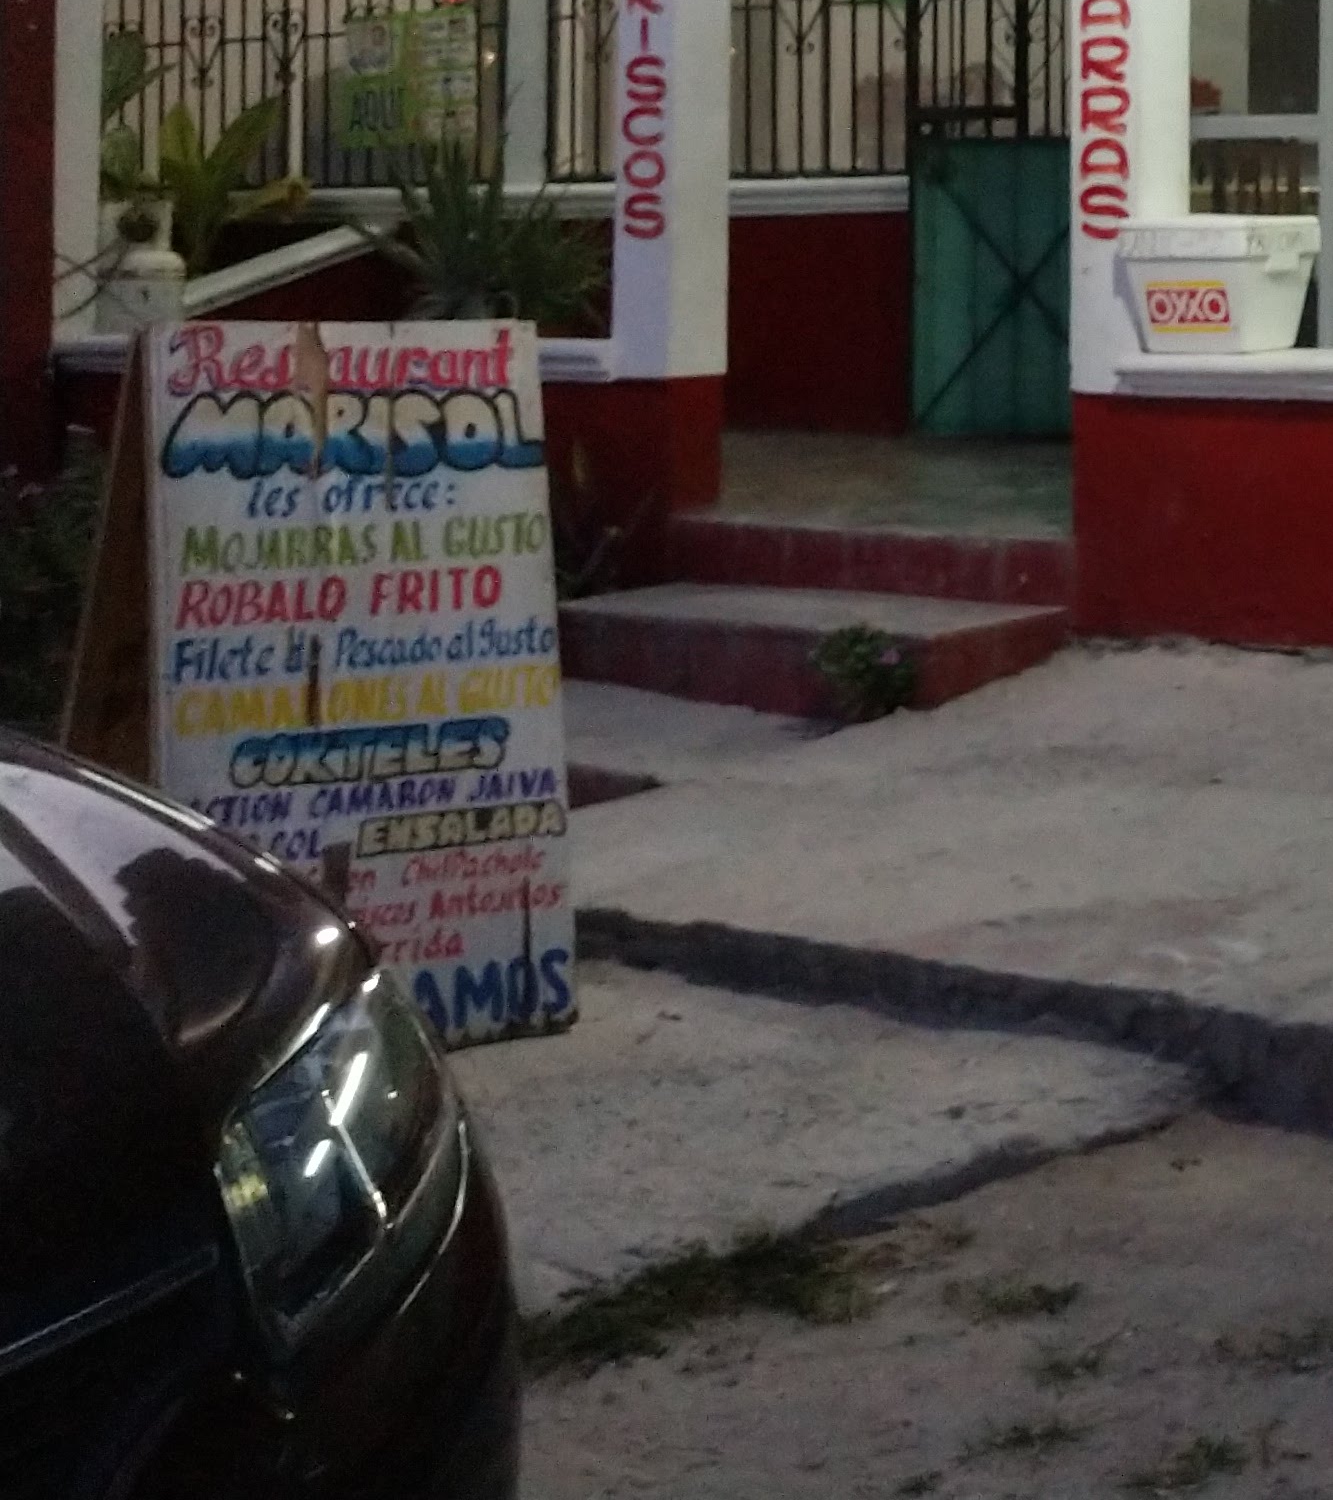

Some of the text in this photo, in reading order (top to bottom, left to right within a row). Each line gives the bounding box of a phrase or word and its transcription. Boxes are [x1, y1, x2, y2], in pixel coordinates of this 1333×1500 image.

[1148, 288, 1229, 323] OXXO
[168, 325, 514, 396] Resaurant
[162, 388, 545, 480] MARISOL
[246, 479, 298, 518] les
[181, 511, 548, 576] MOJARRAS AL GUSTO
[176, 565, 504, 631] ROBALO FRITO
[173, 633, 276, 684] Filete
[335, 627, 441, 669] Pescado
[175, 676, 407, 738] CAMAONES
[230, 715, 511, 790] COKTELES
[310, 777, 457, 819] CAMARON
[467, 768, 557, 803] JAIVA
[357, 799, 567, 858] ENSALADA
